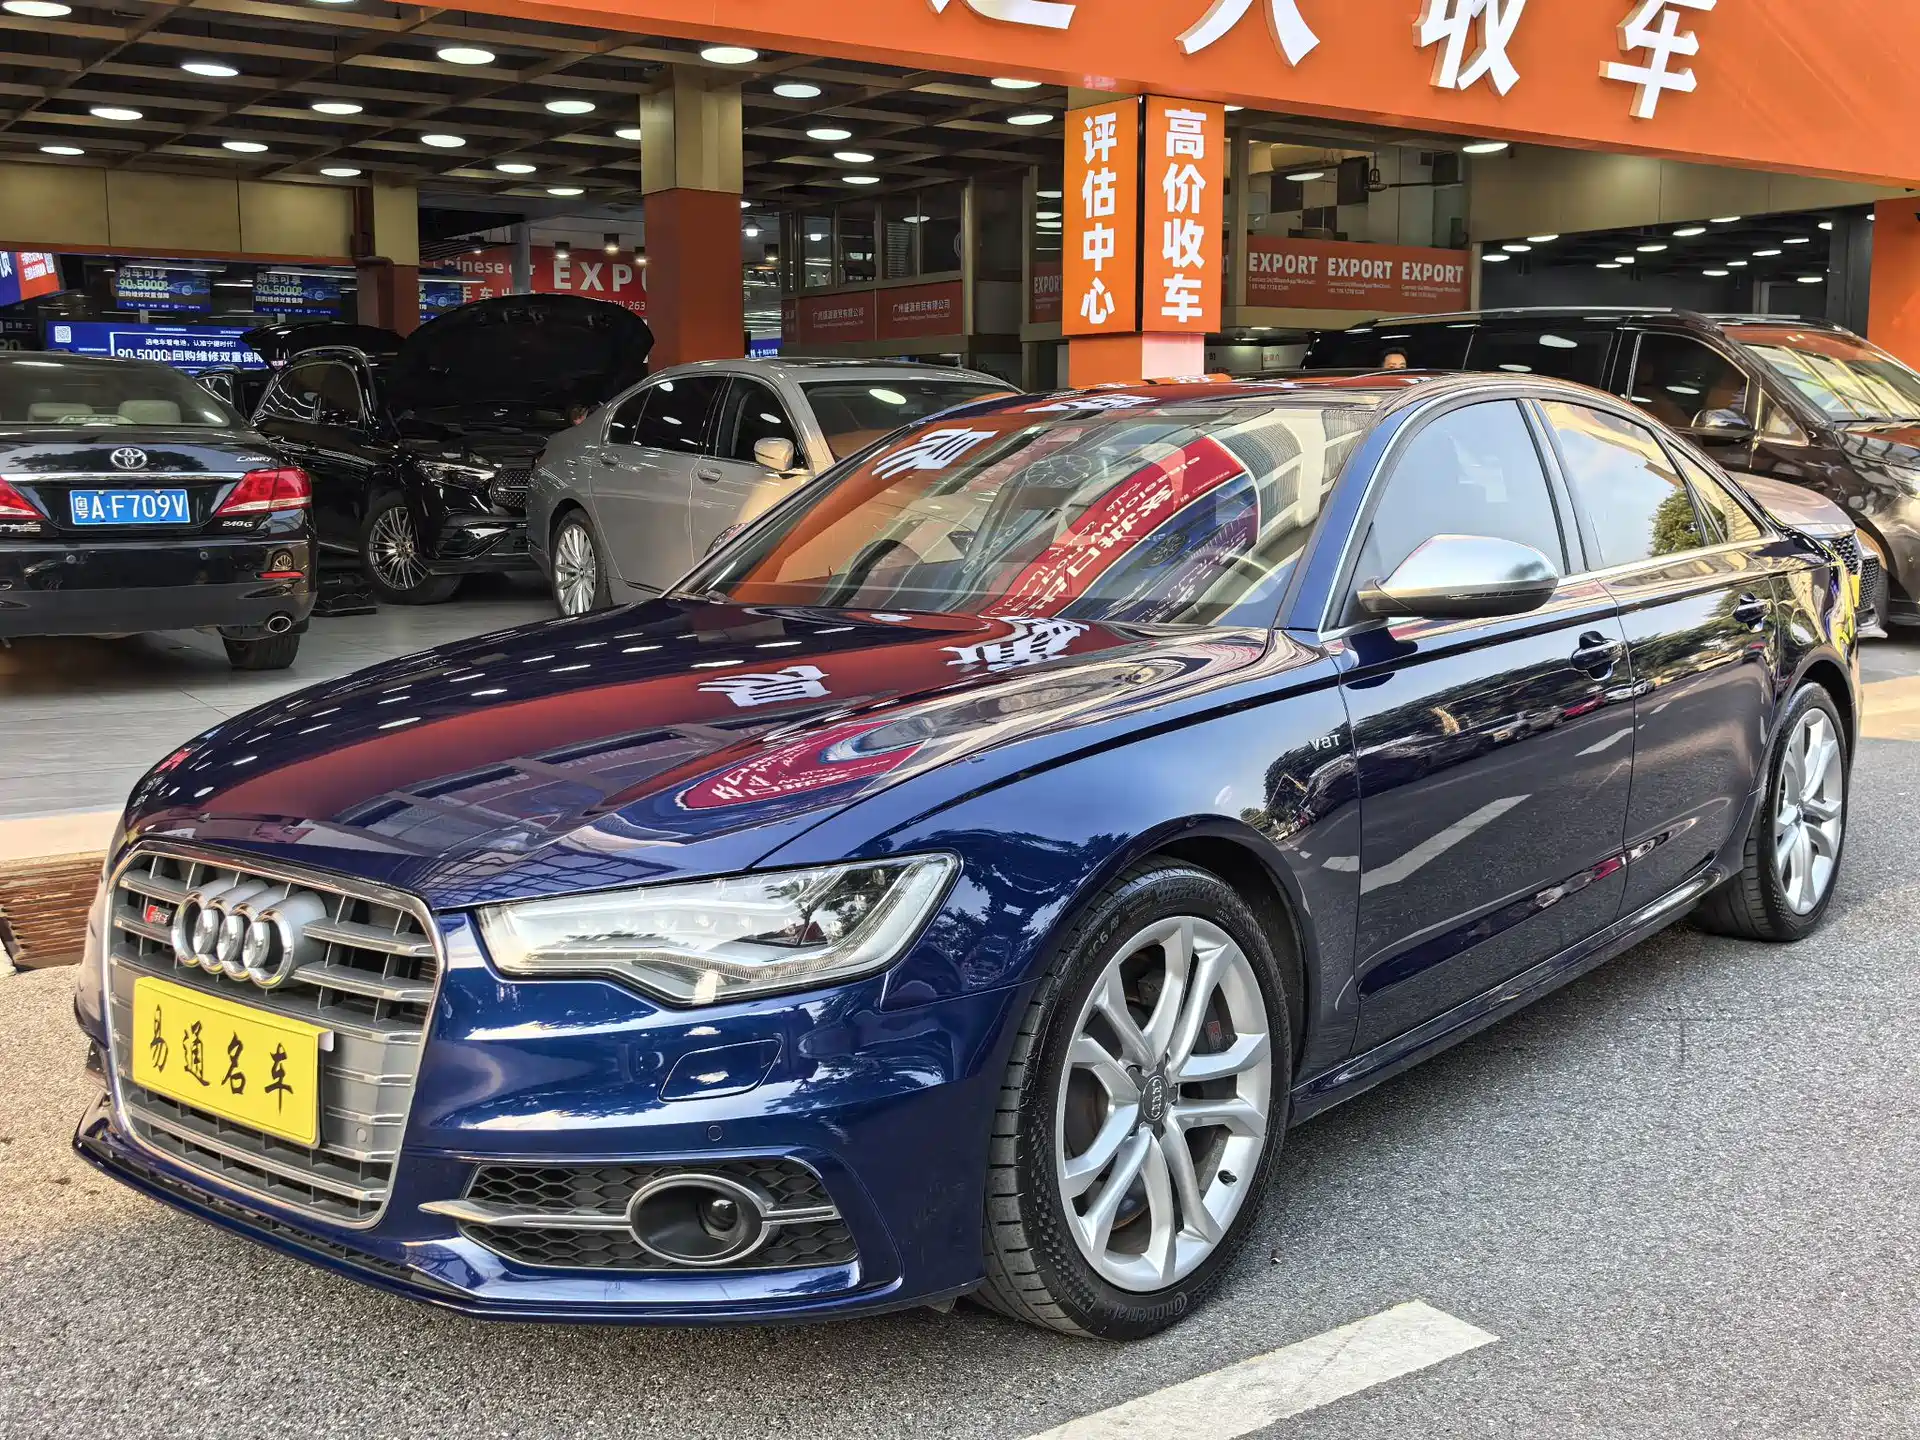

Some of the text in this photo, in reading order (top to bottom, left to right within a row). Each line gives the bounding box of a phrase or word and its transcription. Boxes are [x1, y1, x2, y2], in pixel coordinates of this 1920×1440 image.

[1081, 112, 1118, 324] 评估中心
[1161, 109, 1207, 323] 高价收车
[1248, 252, 1464, 284] EXPORT EXPORT EXPORT
[1033, 275, 1063, 293] EXPOR
[149, 1004, 293, 1114] 易通名车
